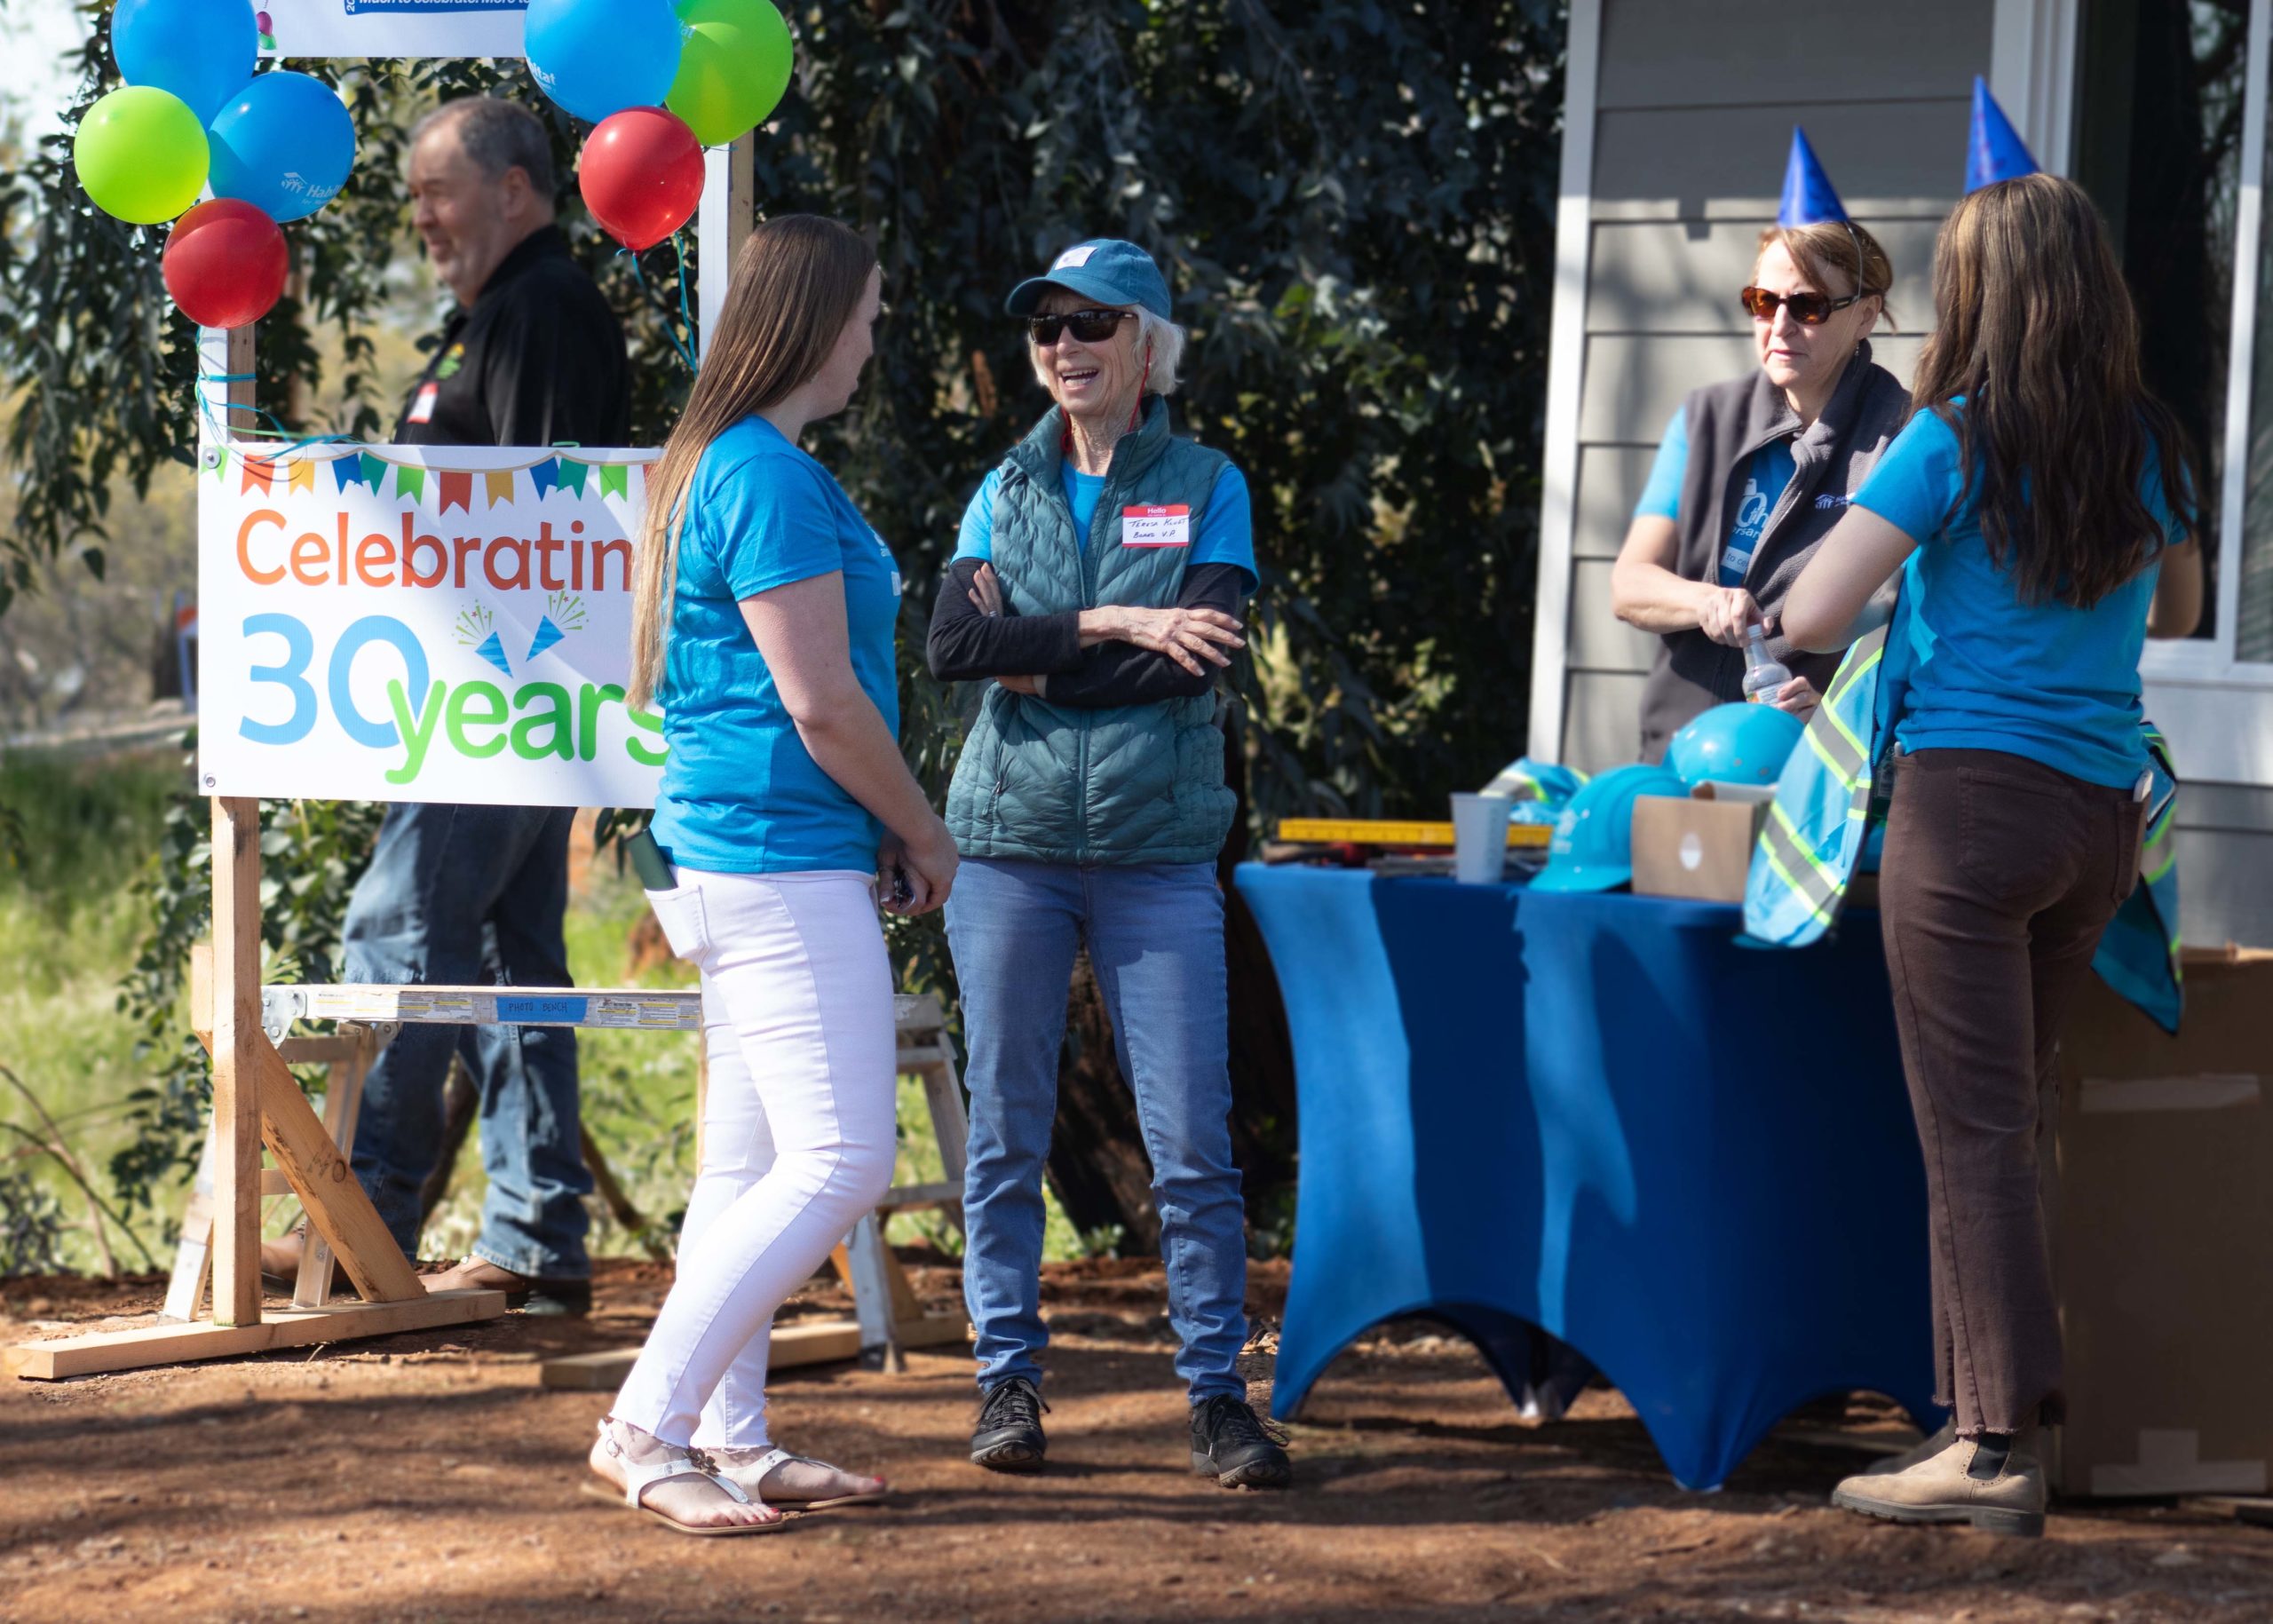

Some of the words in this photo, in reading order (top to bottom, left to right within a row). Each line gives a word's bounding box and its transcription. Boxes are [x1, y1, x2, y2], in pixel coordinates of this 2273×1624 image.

[236, 508, 633, 592] Celebratin
[238, 612, 431, 749] 30
[384, 678, 671, 785] years
[509, 1001, 533, 1012] PHOTO
[543, 1001, 568, 1012] BENCH
